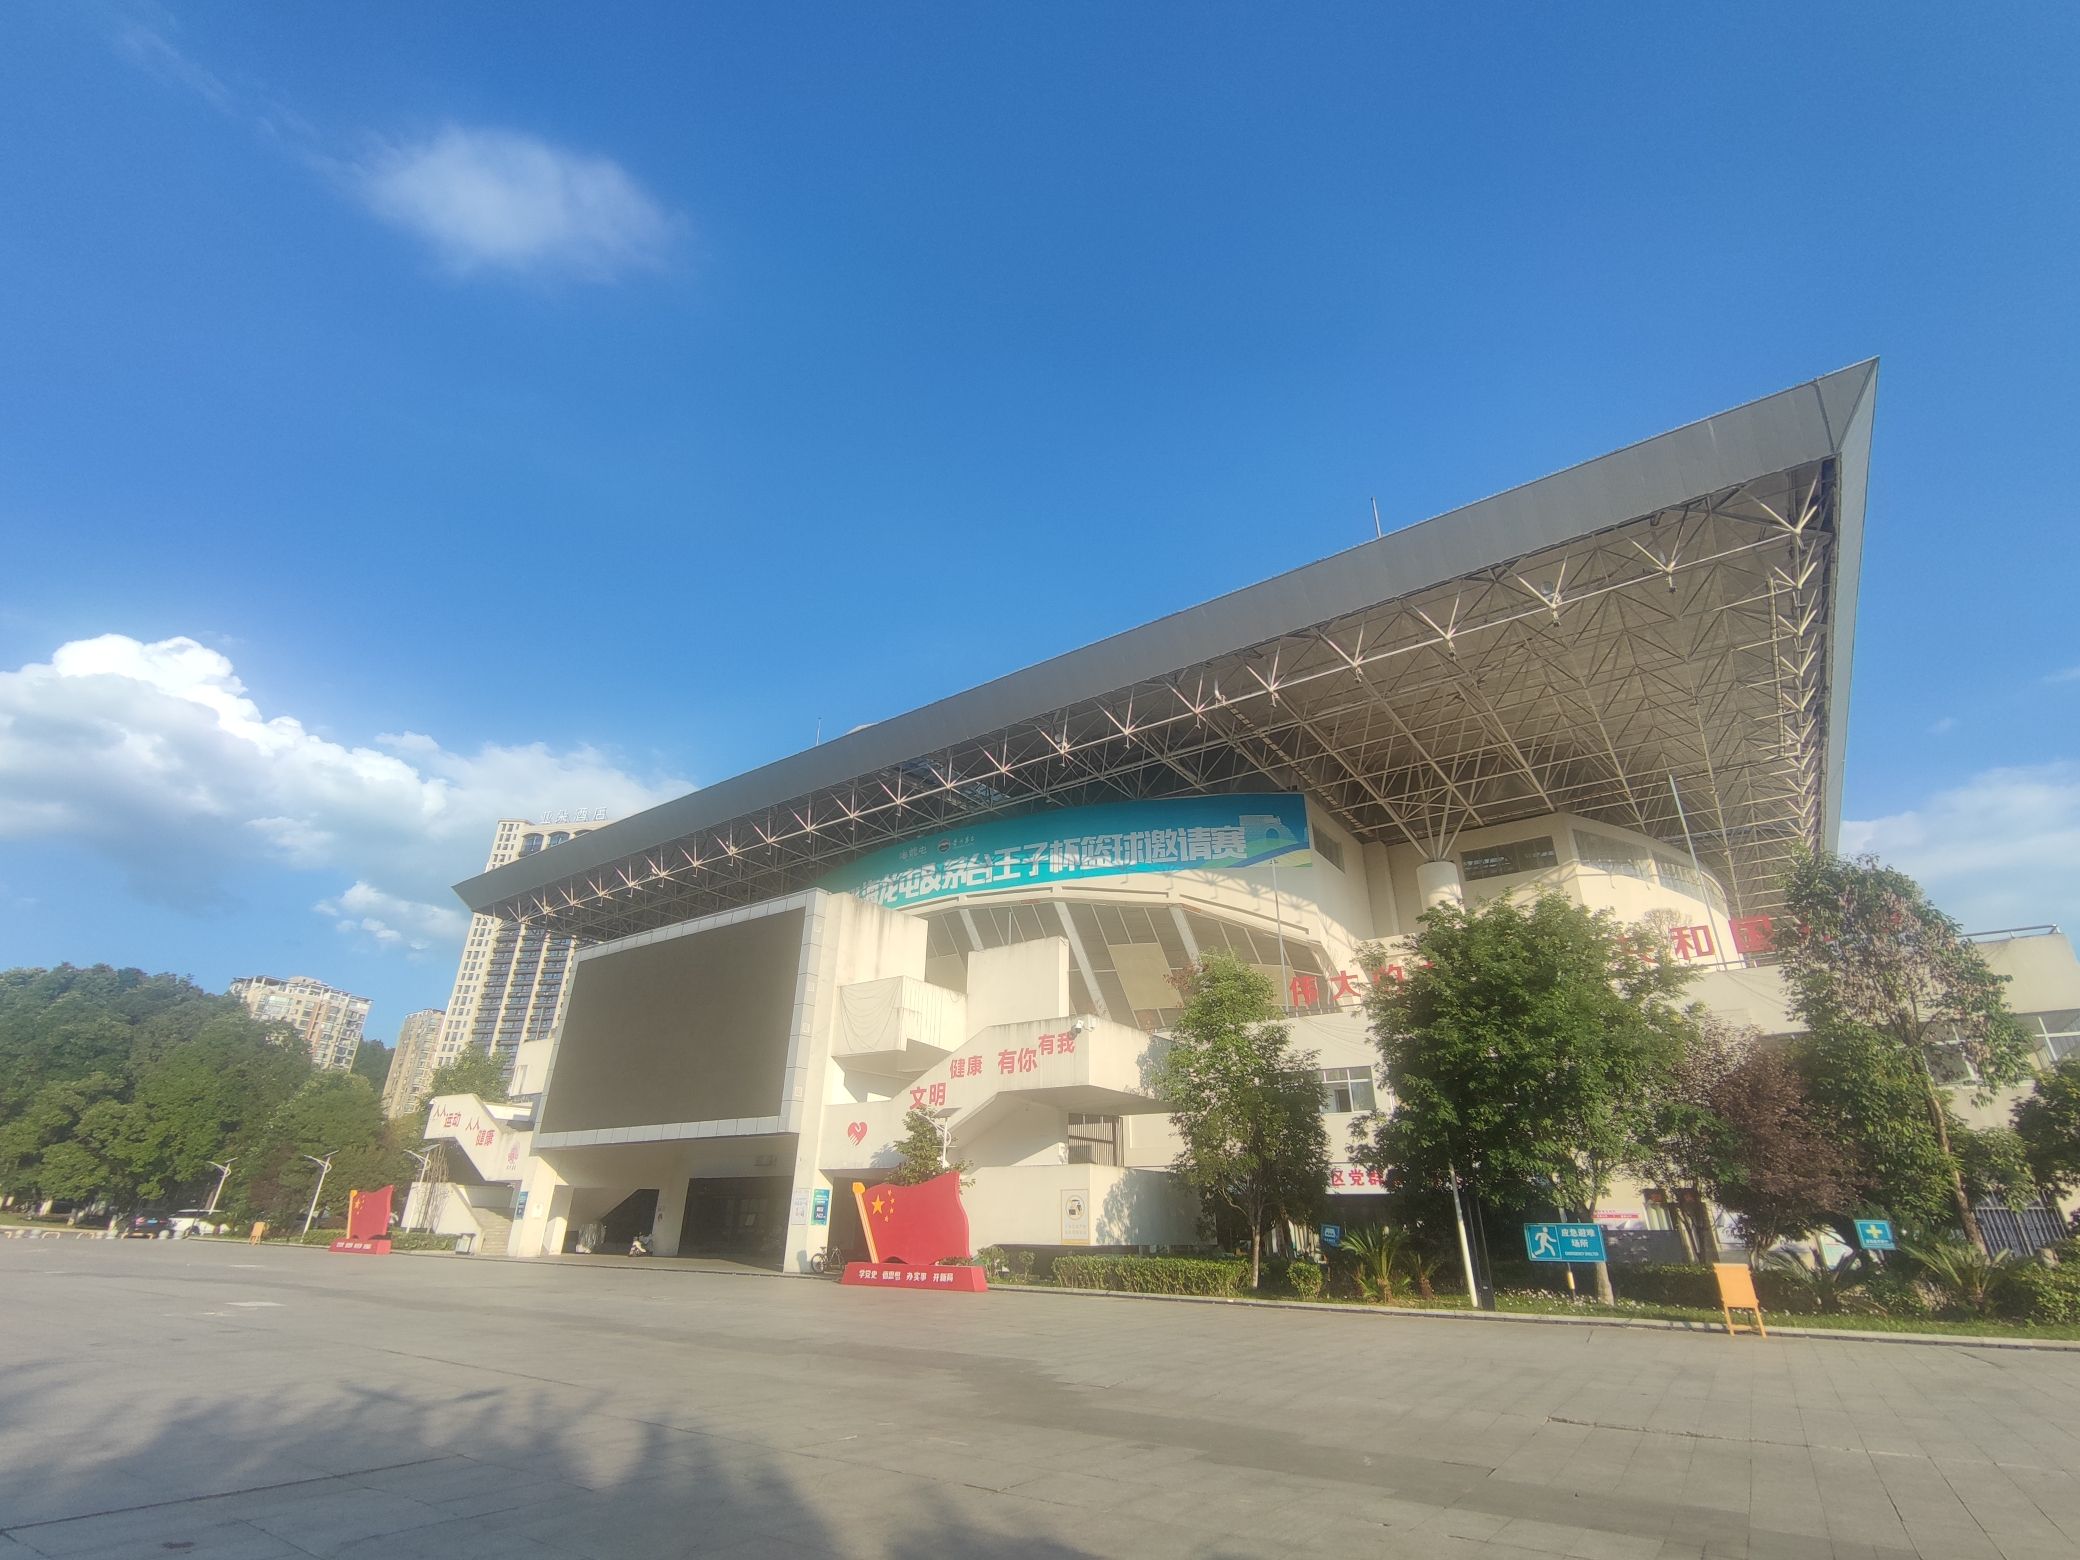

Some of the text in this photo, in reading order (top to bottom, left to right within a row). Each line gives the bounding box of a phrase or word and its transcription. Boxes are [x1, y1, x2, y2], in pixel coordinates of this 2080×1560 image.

[541, 806, 608, 824] 亚朵酒店
[998, 1031, 1076, 1075] 有你 有我
[909, 1055, 983, 1110] 文明 健康
[444, 1111, 462, 1128] 运动
[475, 1129, 496, 1147] 健康
